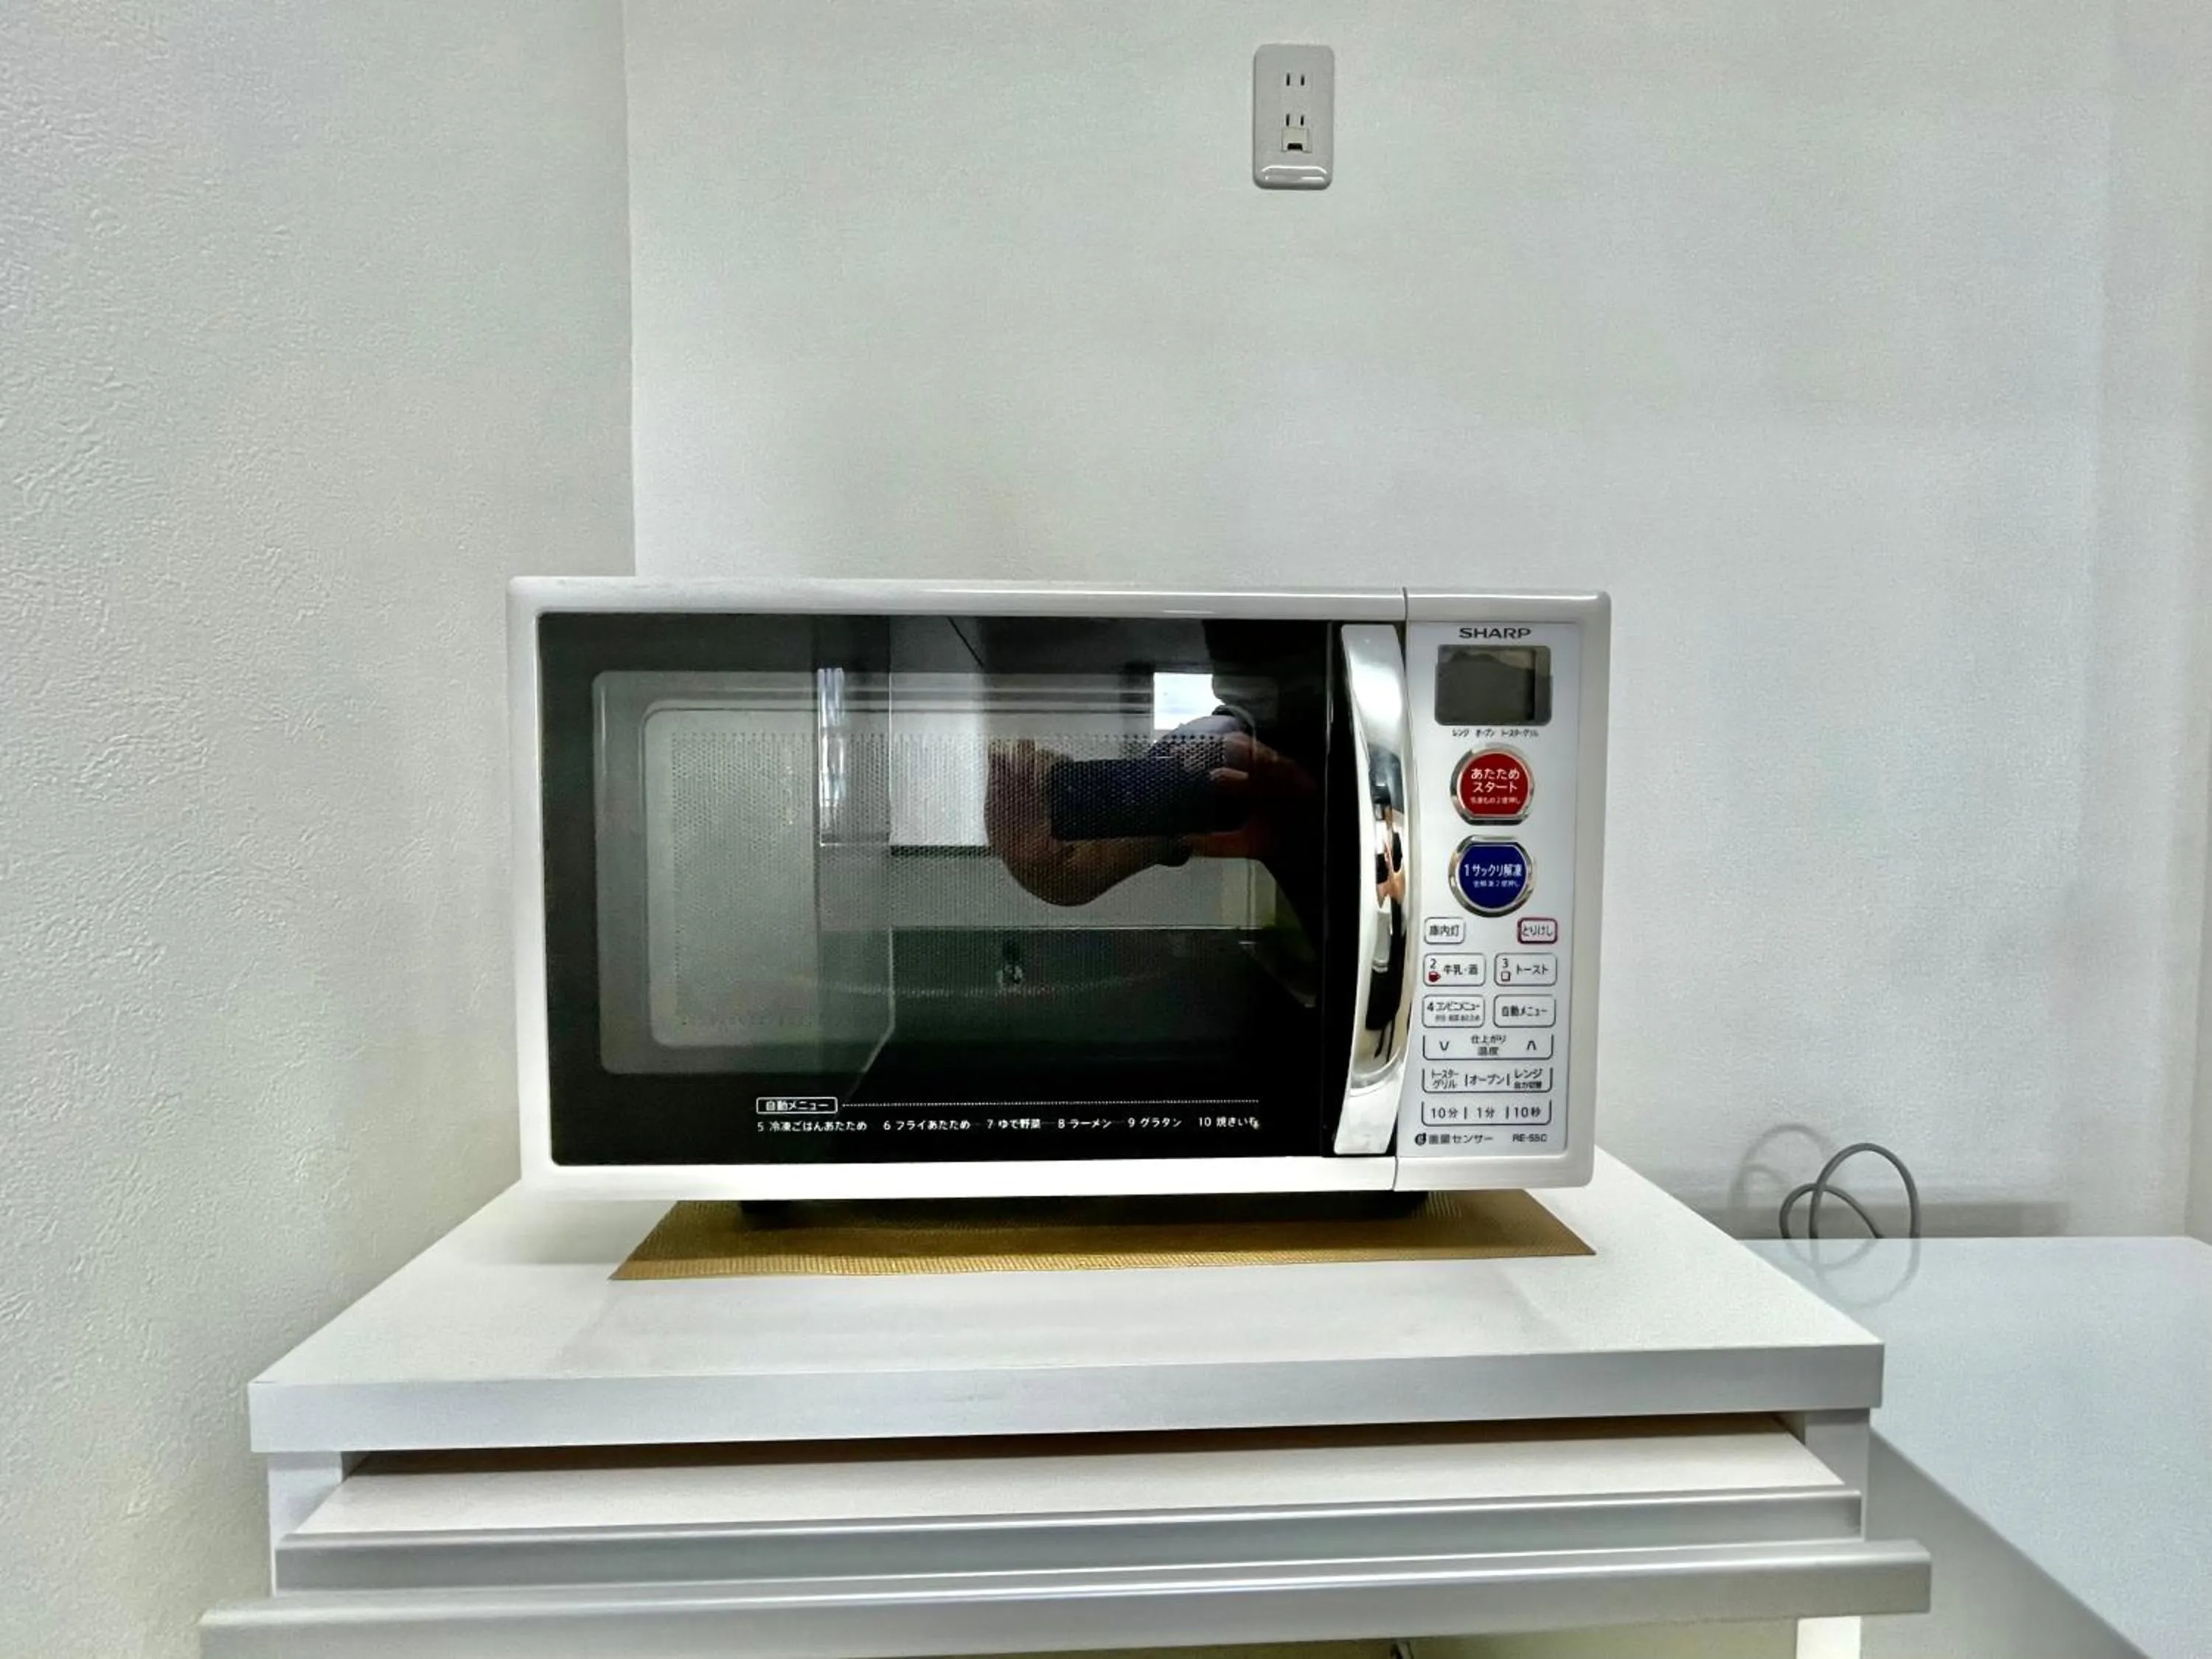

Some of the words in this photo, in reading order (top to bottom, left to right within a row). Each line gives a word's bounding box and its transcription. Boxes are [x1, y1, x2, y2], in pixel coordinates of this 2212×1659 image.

[1458, 627, 1531, 639] SHARP
[1471, 768, 1520, 779] あたため
[1472, 782, 1517, 793] スタート
[1430, 925, 1459, 936] 庫内灯
[1522, 926, 1553, 936] とりけし
[1430, 959, 1436, 969] 2
[1502, 959, 1509, 968] 3
[1516, 964, 1548, 974] トースト
[1501, 1006, 1547, 1017] 自動メニュー
[1471, 1034, 1506, 1045] 仕上がり
[1431, 1068, 1458, 1078] トースター
[1514, 1068, 1543, 1079] レンジ
[1433, 1079, 1457, 1089] グリル
[1470, 1074, 1504, 1086] オーブン
[765, 1101, 829, 1111] 自動メニュー
[1431, 1107, 1458, 1118] 10分
[1477, 1107, 1495, 1118] 1分
[1514, 1107, 1541, 1118] 10秒
[757, 1121, 765, 1131] 5
[883, 1121, 891, 1130] 6
[896, 1119, 970, 1130] フライあたため
[987, 1119, 994, 1129] 7
[1057, 1119, 1065, 1129] 8
[1069, 1119, 1112, 1129] ラーメン
[1127, 1118, 1135, 1127] 9
[1141, 1117, 1182, 1128] グラタン
[1198, 1116, 1211, 1127] 10
